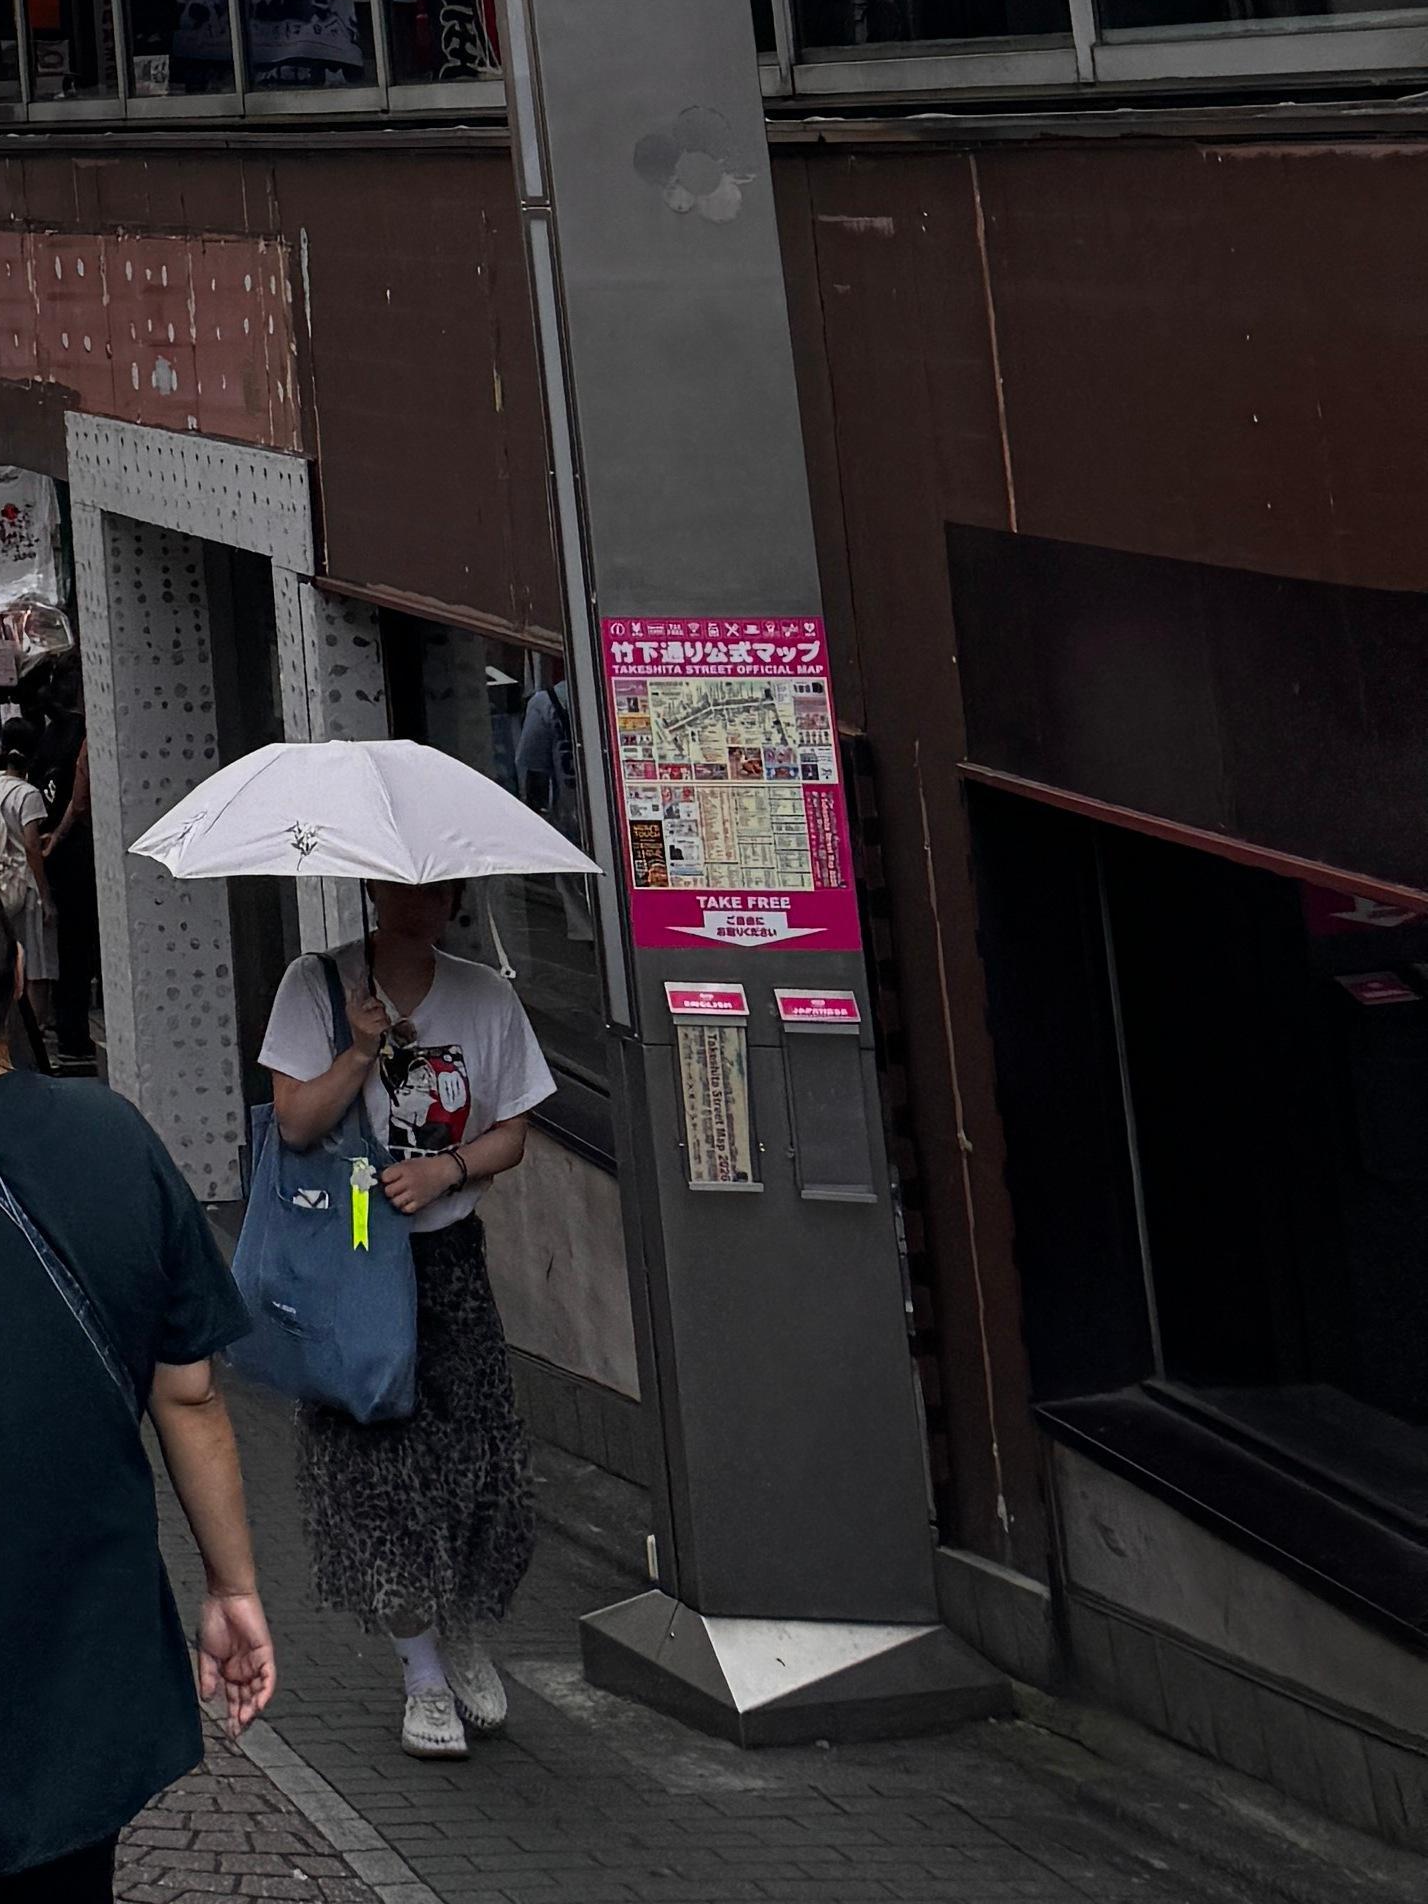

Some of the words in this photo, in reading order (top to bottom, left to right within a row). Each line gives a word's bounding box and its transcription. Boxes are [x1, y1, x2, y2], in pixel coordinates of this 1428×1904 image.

[610, 639, 821, 665] 竹下通り公式マップ
[611, 664, 683, 675] TAKESHITA
[685, 665, 733, 675] STREET
[736, 665, 794, 675] OFFICIAL
[796, 665, 825, 676] MAP
[695, 895, 744, 910] TAKE
[747, 895, 792, 910] FREE
